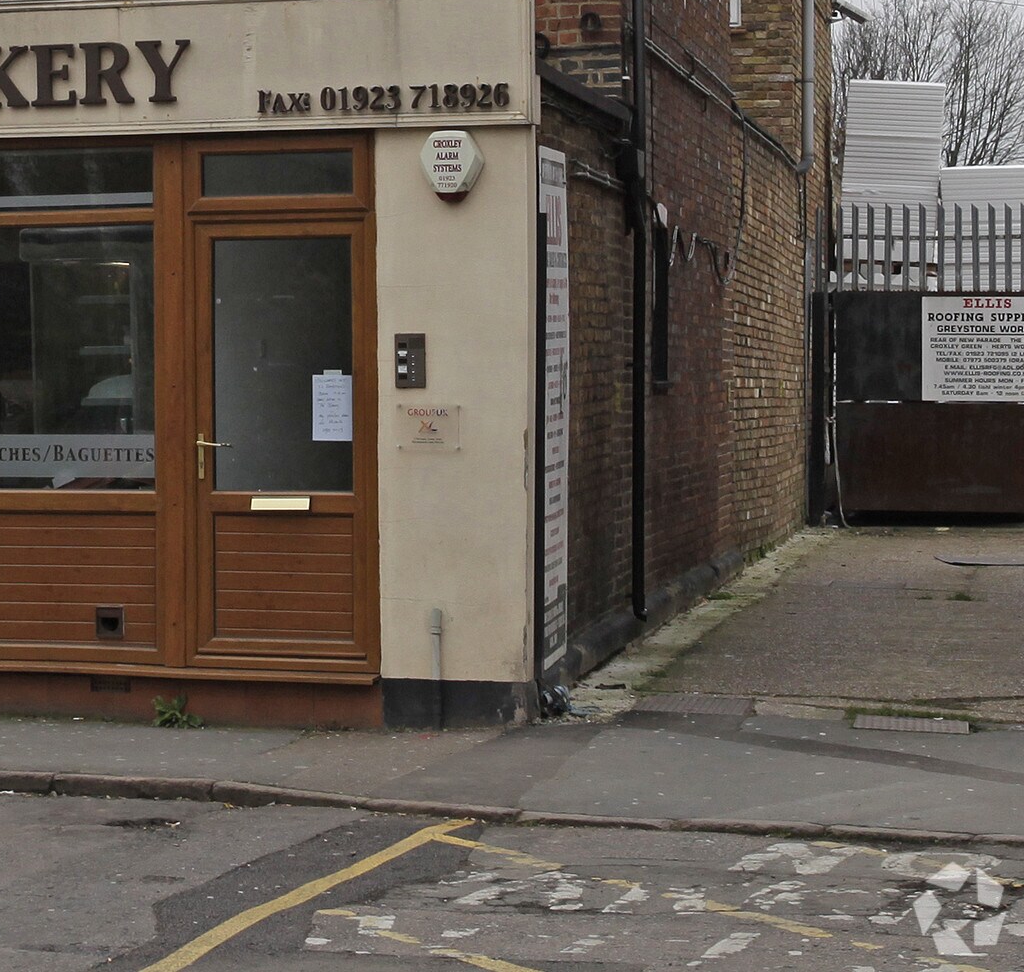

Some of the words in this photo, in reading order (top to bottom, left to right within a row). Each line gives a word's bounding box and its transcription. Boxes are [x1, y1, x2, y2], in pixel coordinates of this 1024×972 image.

[320, 85, 402, 112] 01923
[409, 82, 511, 109] 718926
[433, 139, 462, 148] CROXLEY
[436, 152, 459, 160] ALARM
[433, 164, 462, 173] SYSTEMS
[963, 298, 1012, 309] ELLIS
[927, 313, 984, 322] ROOFING
[937, 325, 996, 333] GREYSTONE
[999, 325, 1024, 333] WOR
